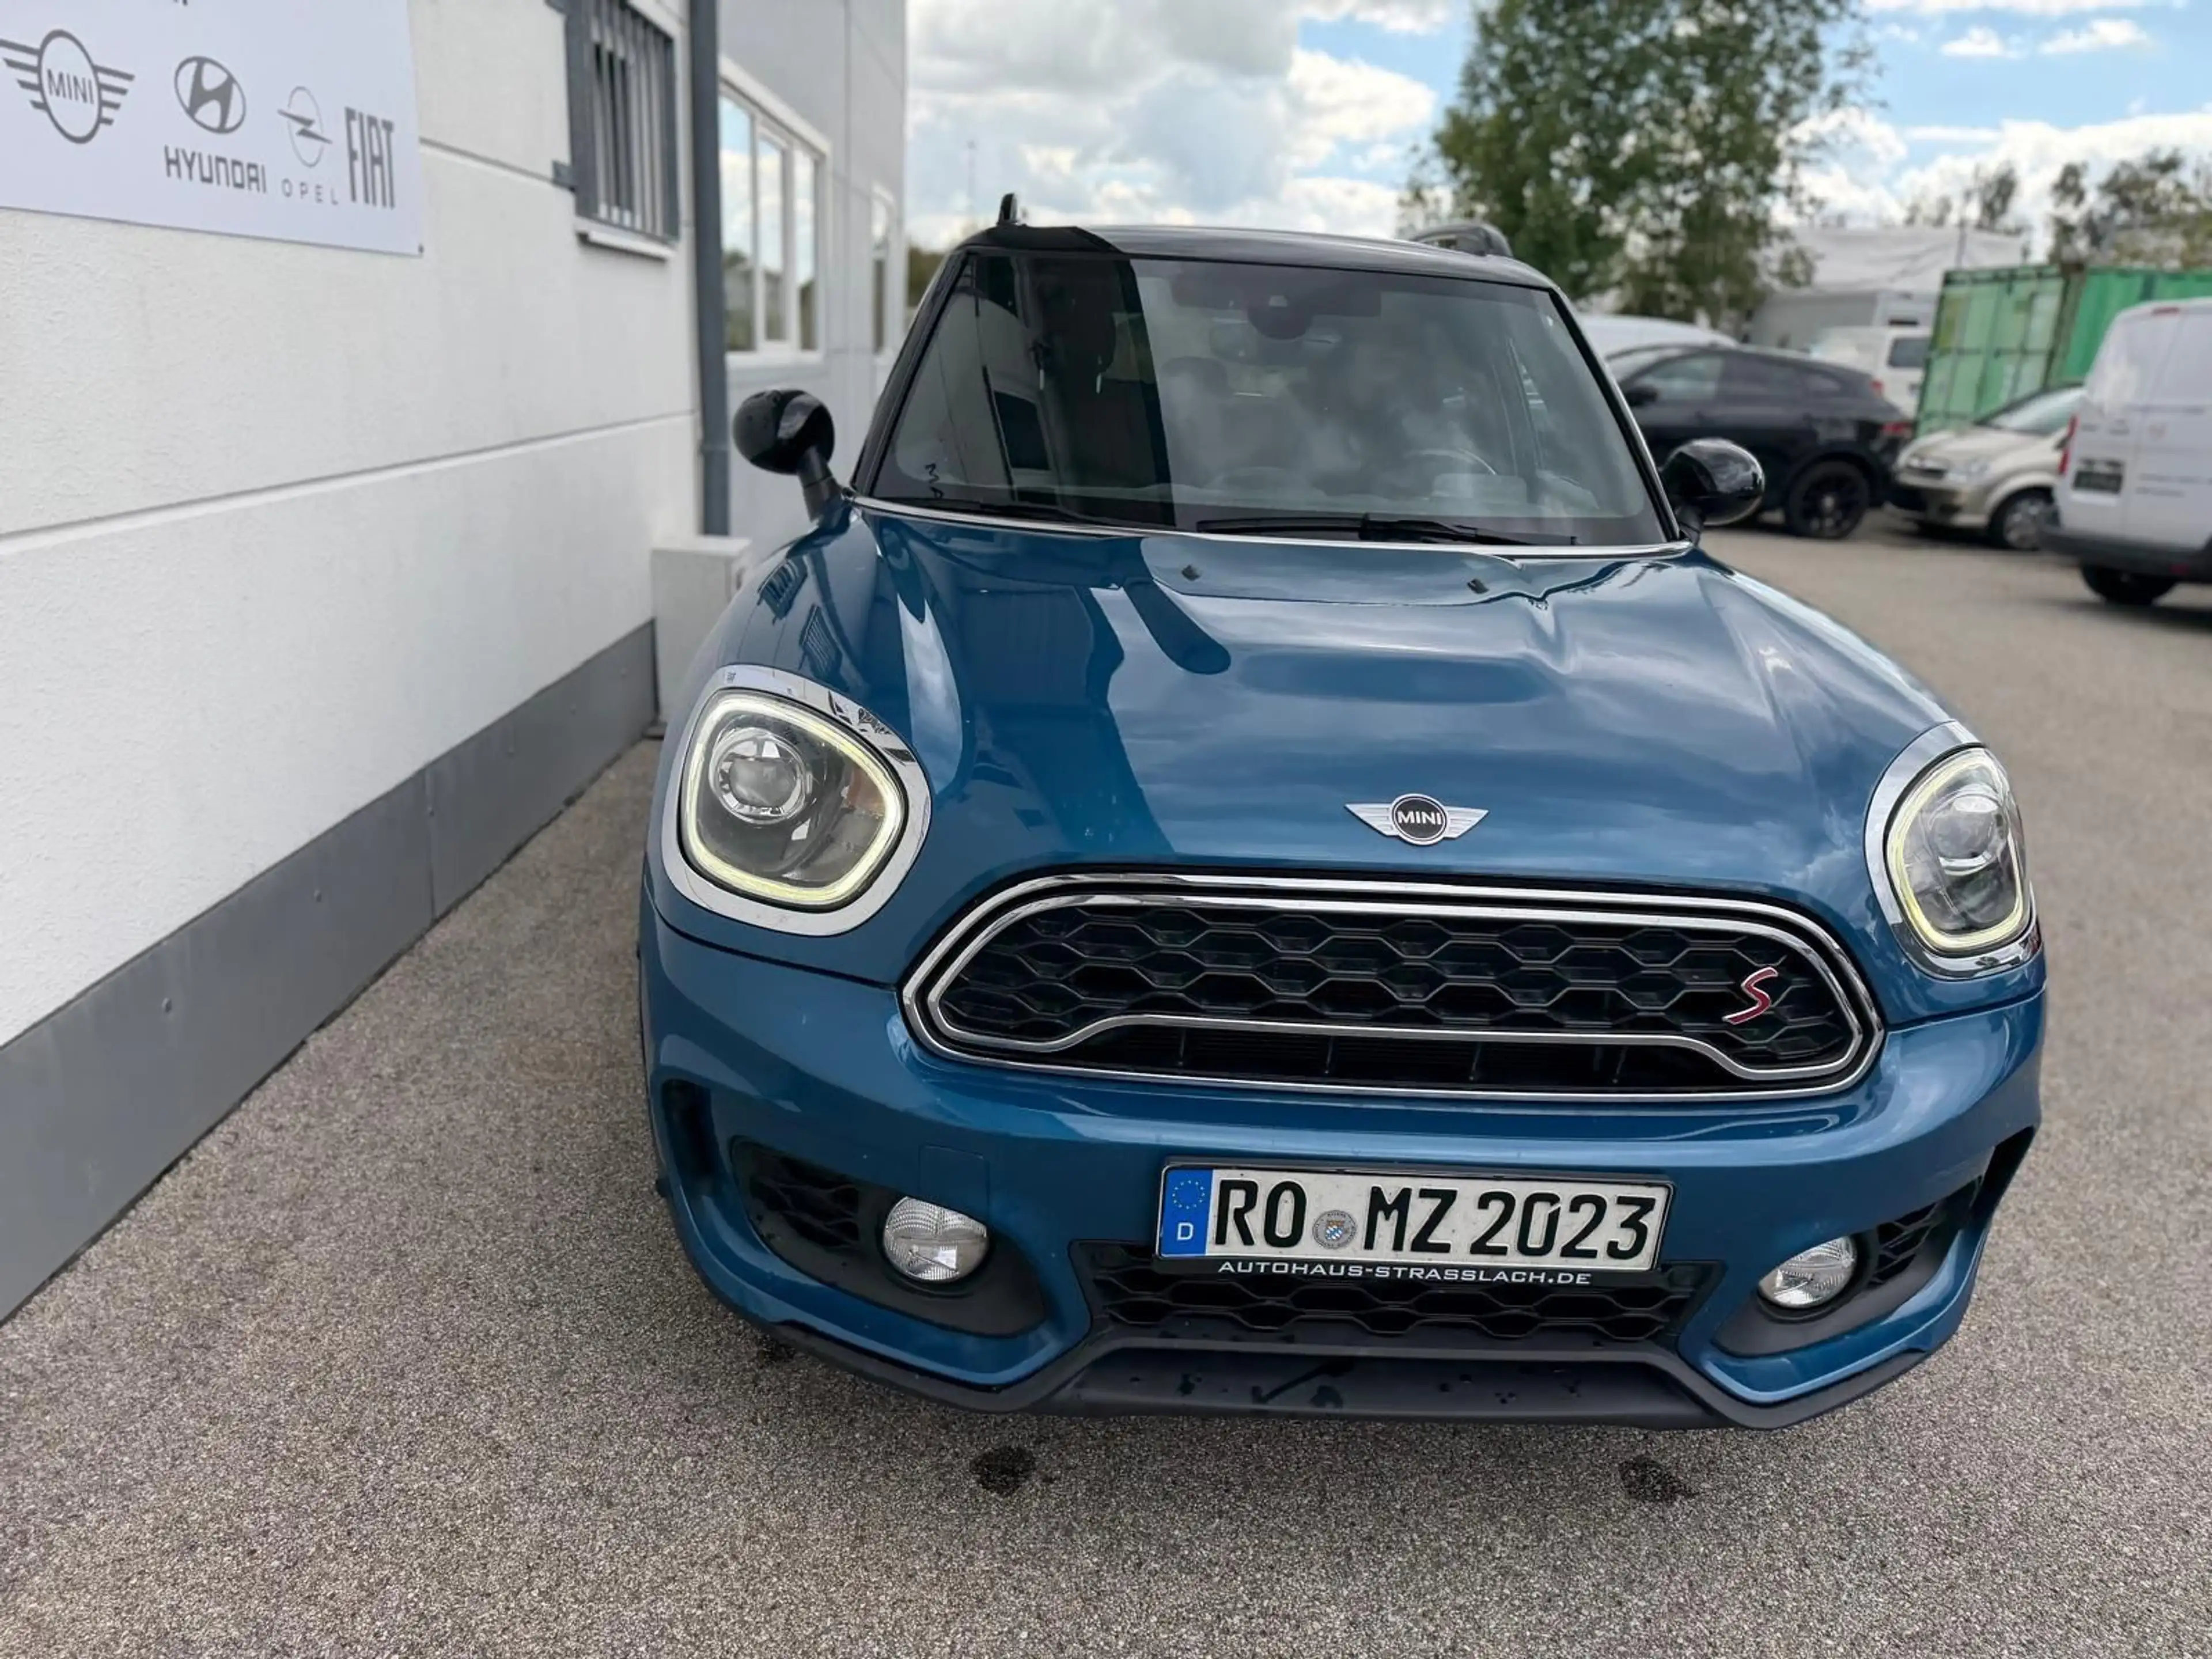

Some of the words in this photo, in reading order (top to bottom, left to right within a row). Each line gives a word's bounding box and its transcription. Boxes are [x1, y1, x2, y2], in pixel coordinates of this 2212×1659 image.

[47, 69, 94, 105] MINI
[164, 145, 267, 194] HYUNDAI
[344, 107, 395, 209] FIAT
[281, 178, 339, 206] OPEL
[1397, 810, 1442, 825] MINI
[1722, 967, 1779, 1025] S
[1177, 1222, 1194, 1240] D
[1214, 1179, 1307, 1248] RO
[1218, 1262, 1591, 1284] AUTOHAUS-STRASSLACH.DE
